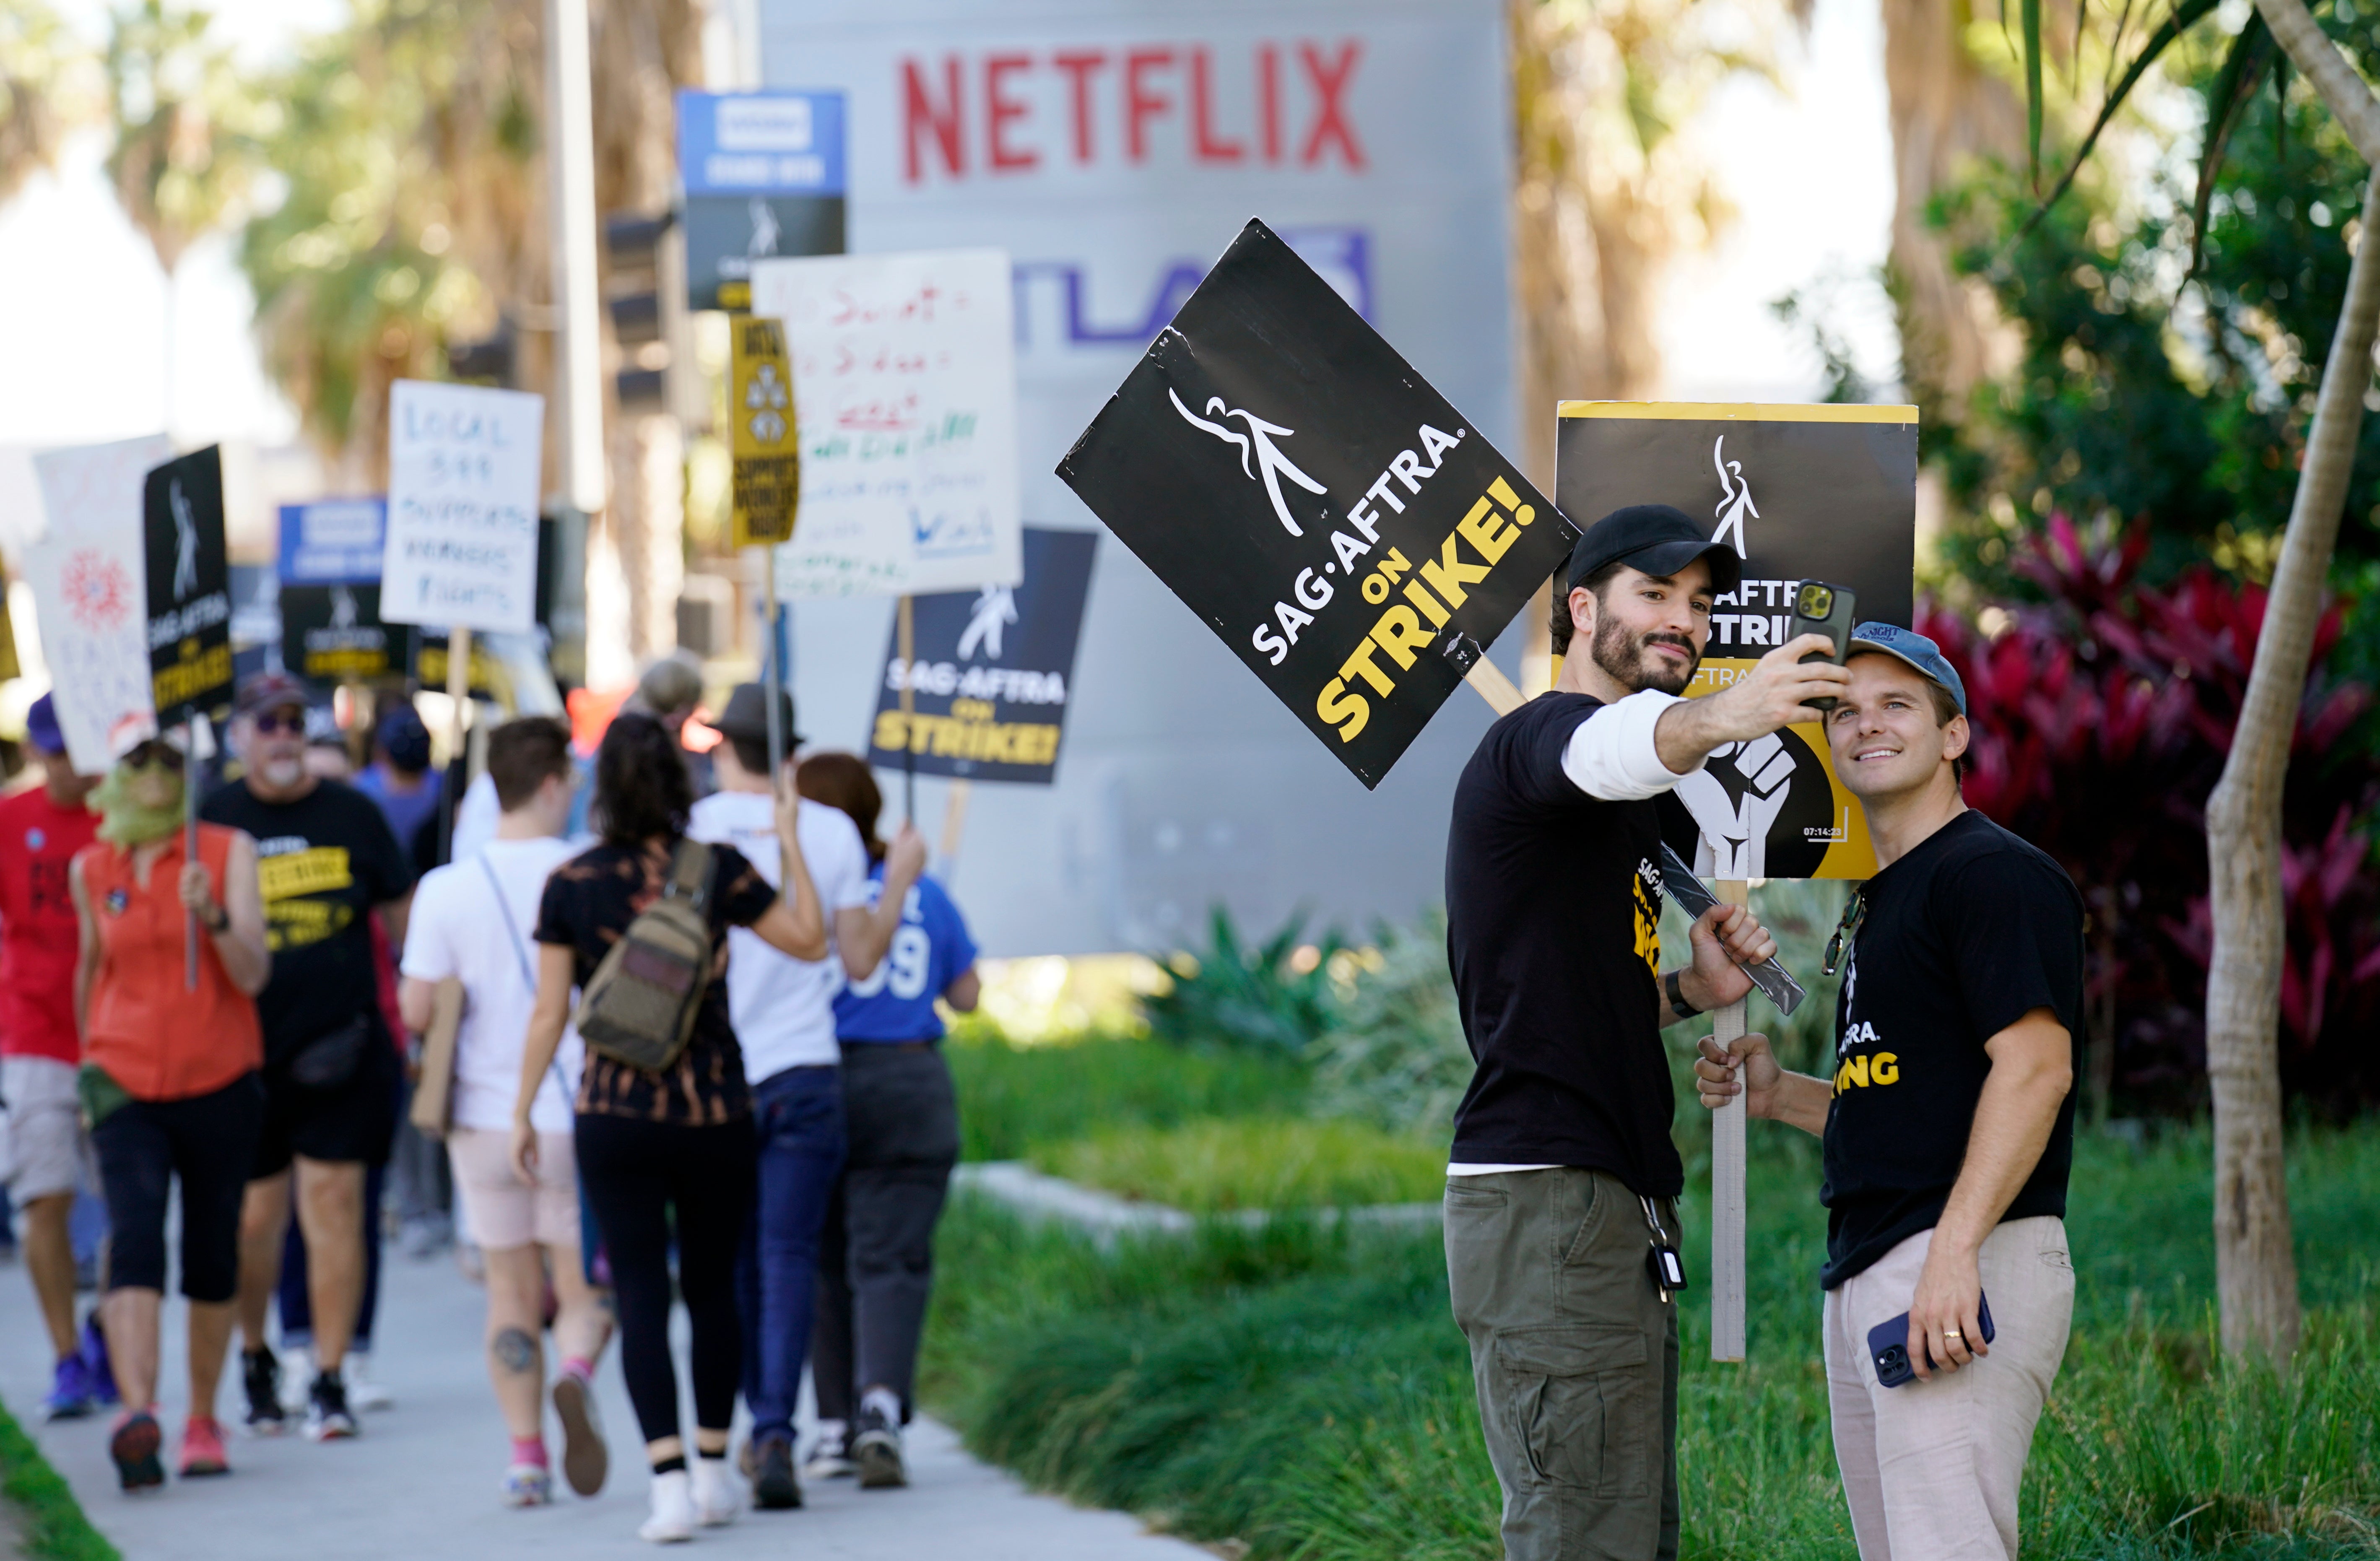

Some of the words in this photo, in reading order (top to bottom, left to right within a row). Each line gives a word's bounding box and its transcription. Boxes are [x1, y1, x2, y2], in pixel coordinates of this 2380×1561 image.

[897, 38, 1370, 187] NETFLIX
[403, 398, 512, 449] LOCAL
[1362, 546, 1412, 604] ON
[1317, 475, 1535, 743] STRIKE!
[873, 709, 1061, 765] STRIKE!
[951, 697, 995, 722] ON
[1804, 827, 1842, 836] 07:14:23
